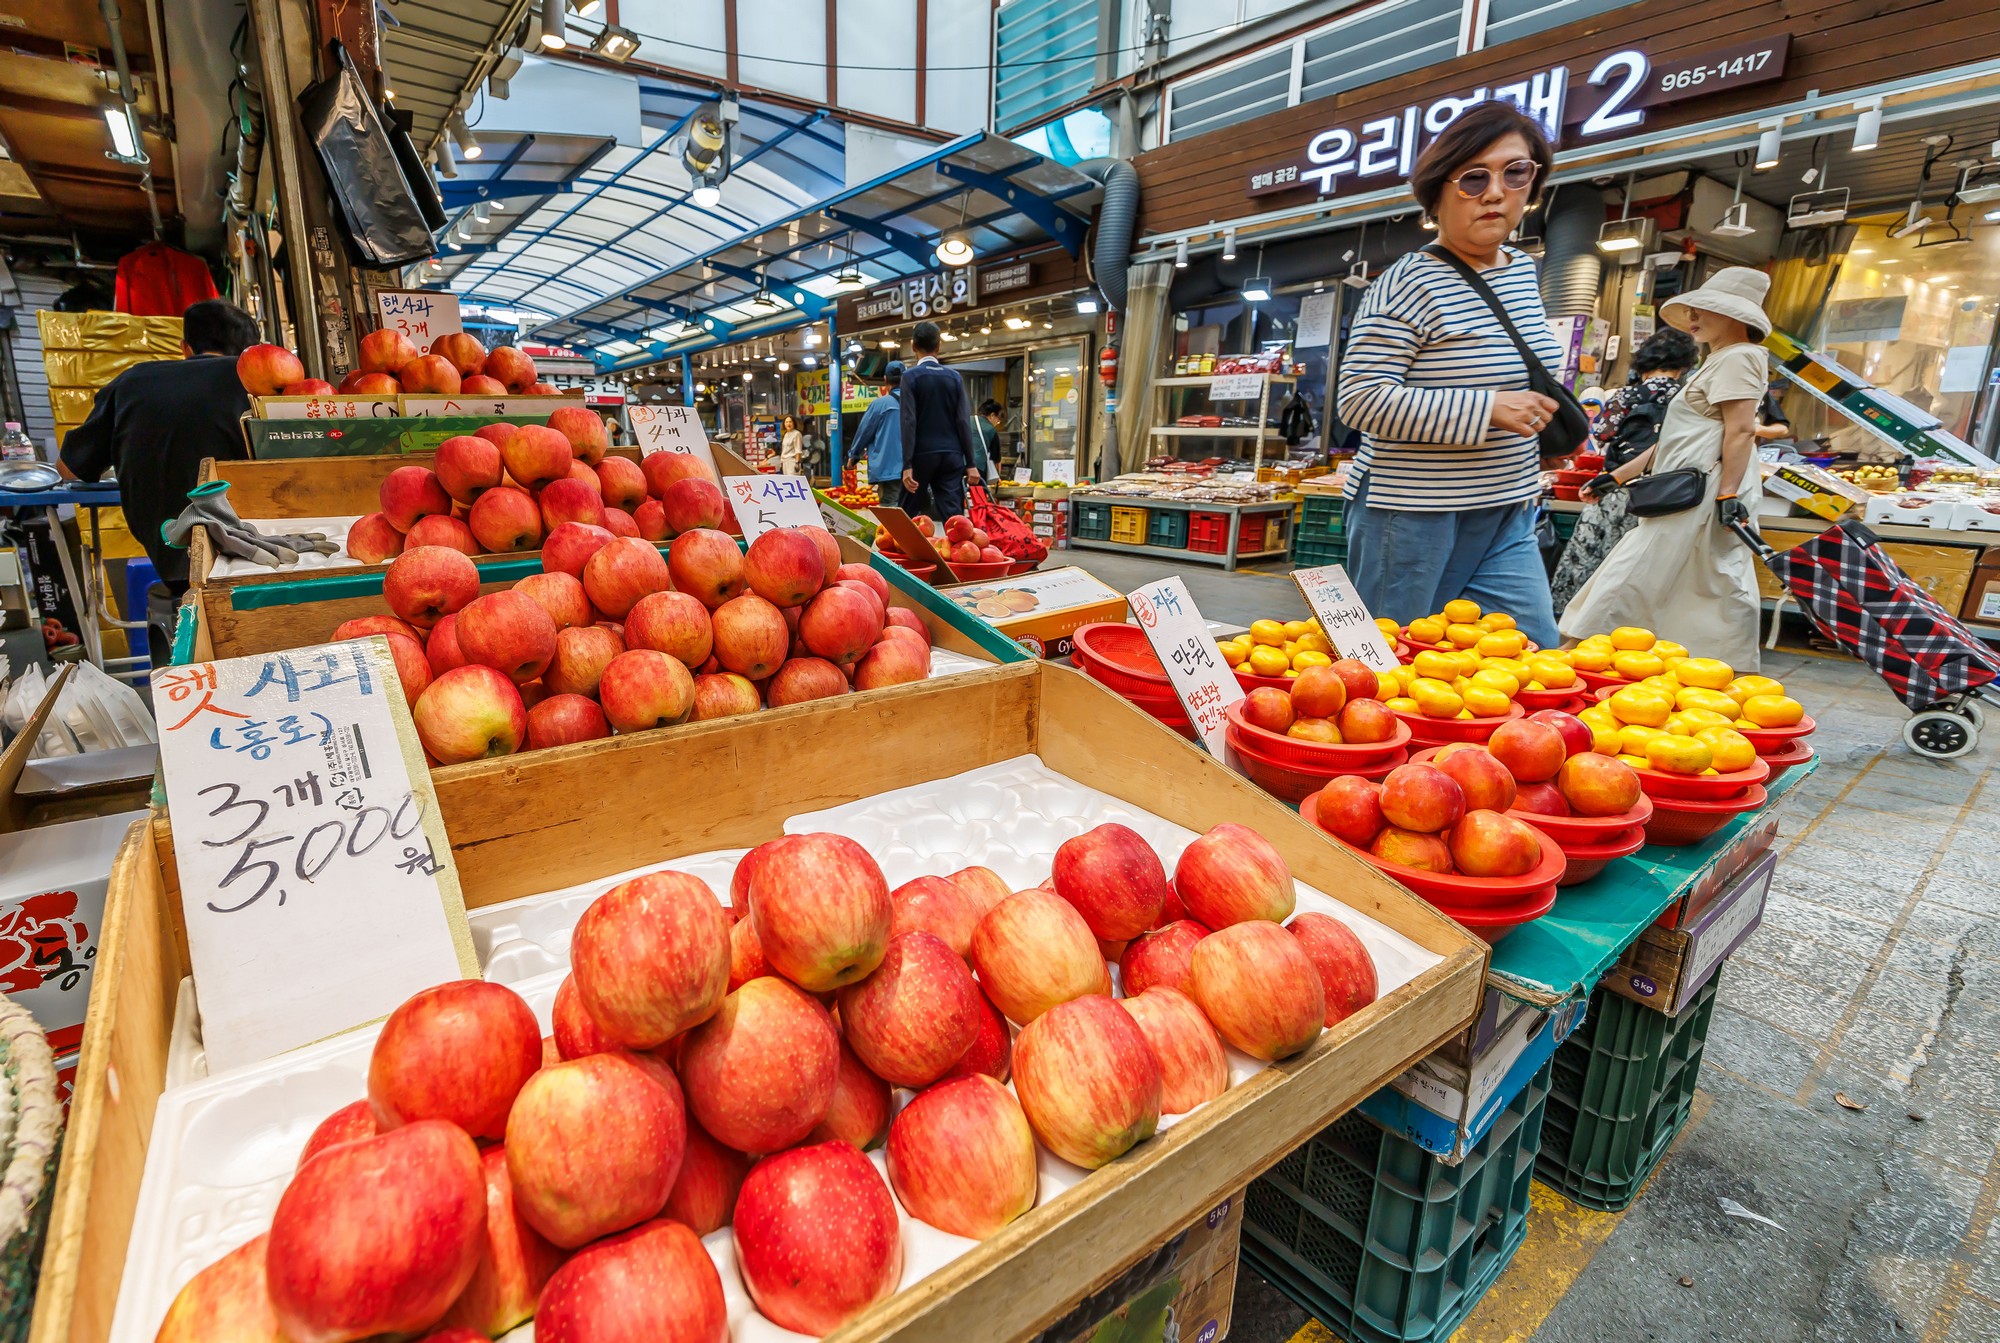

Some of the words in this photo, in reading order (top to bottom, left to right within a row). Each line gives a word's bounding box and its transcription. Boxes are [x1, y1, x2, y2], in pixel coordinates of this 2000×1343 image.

[1660, 49, 1772, 92] 965-1417
[1580, 49, 1652, 137] 2
[656, 406, 690, 424] 사과
[733, 479, 760, 505] 햇
[763, 480, 809, 503] 사과
[1152, 586, 1183, 616] 자두
[160, 662, 252, 731] 햇
[243, 648, 374, 702] 사과
